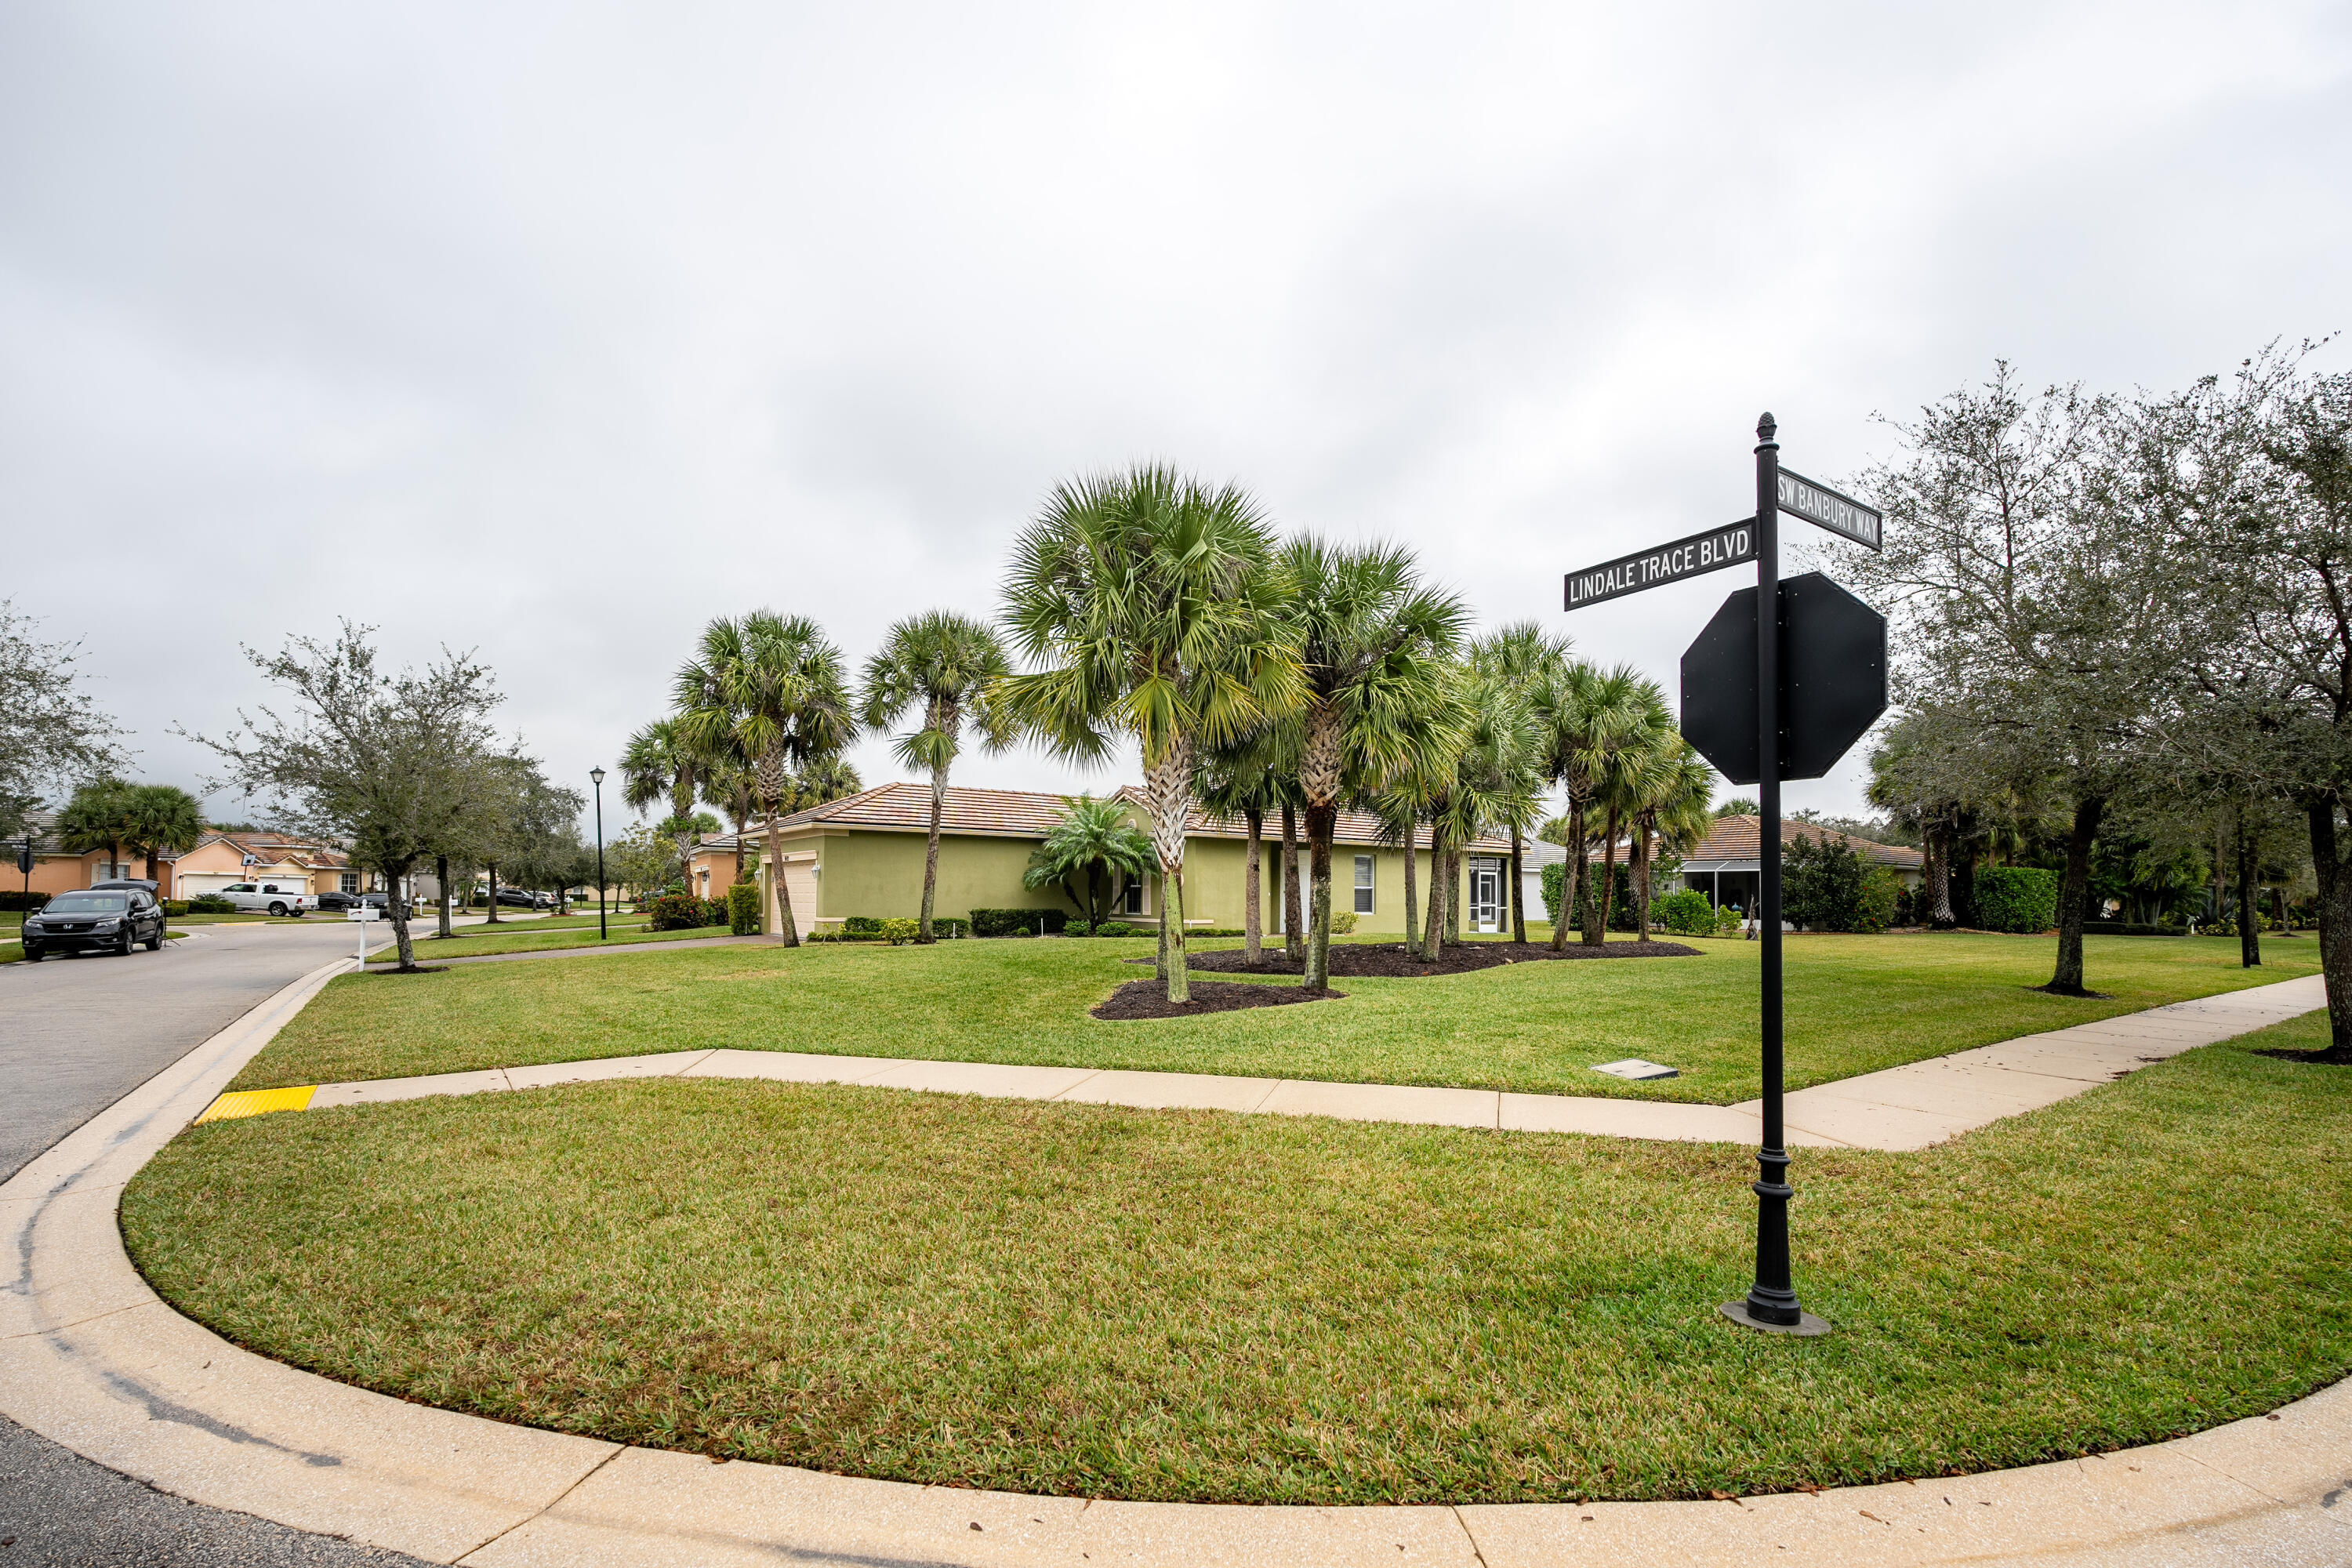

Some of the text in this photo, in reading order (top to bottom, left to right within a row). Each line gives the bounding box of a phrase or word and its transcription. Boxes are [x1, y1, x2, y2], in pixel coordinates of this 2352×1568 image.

[1778, 476, 1878, 541] SW BANBURY WAY
[1570, 529, 1749, 603] LINDALE TRACE BLVD
